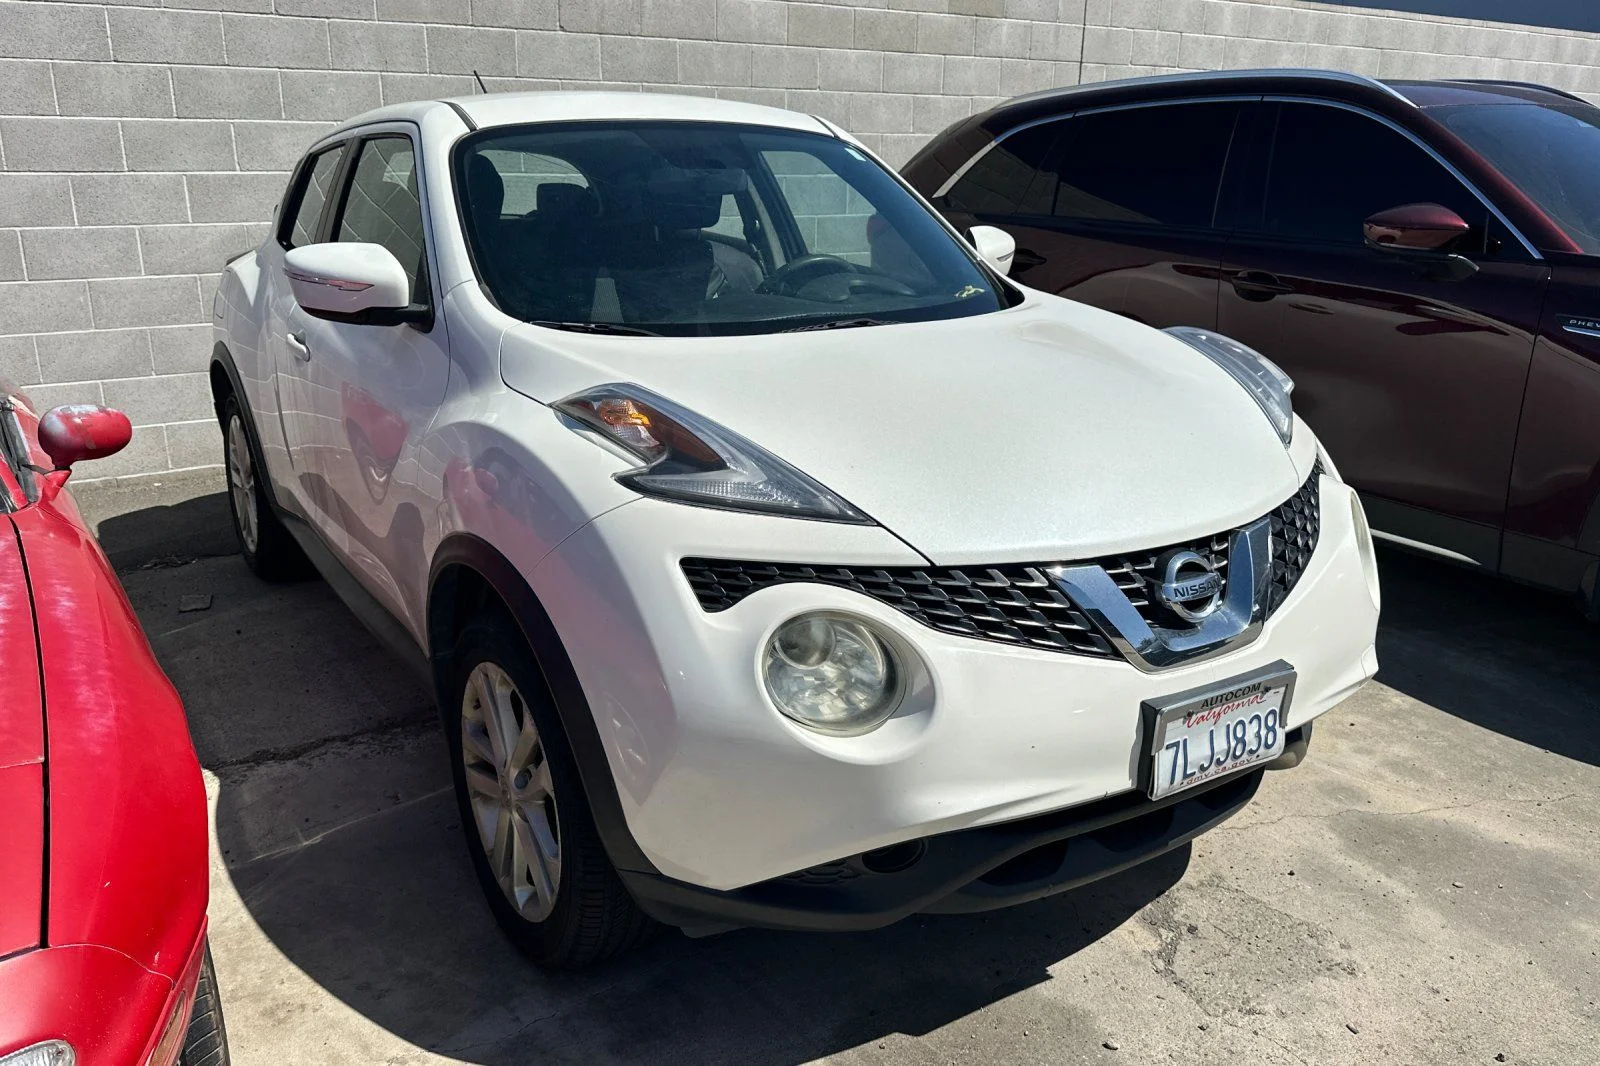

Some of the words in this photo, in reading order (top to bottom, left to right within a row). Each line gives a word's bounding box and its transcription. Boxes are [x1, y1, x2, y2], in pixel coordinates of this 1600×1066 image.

[1173, 578, 1220, 597] NISSAN
[1200, 682, 1262, 709] AUTOCOM
[1186, 694, 1266, 728] California
[1165, 708, 1278, 786] 7LJJ838
[1186, 757, 1254, 786] dmv.ca.gov
